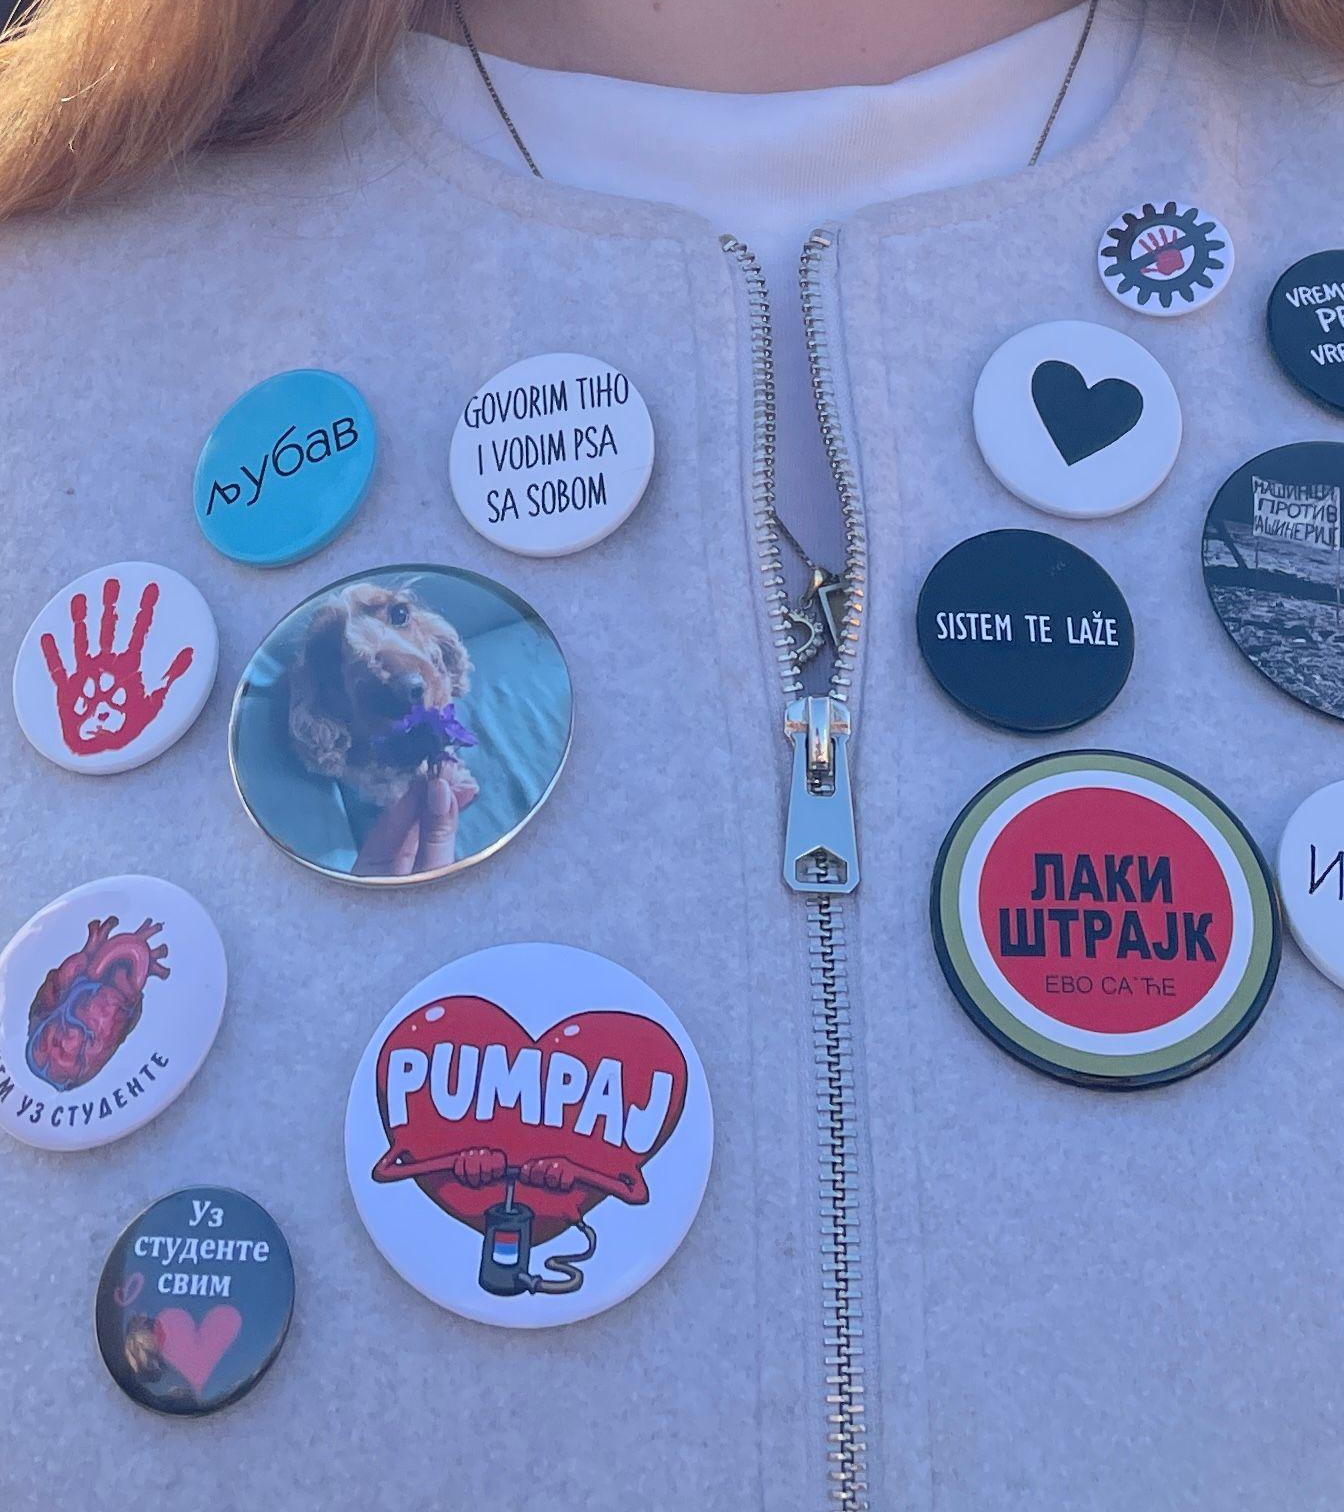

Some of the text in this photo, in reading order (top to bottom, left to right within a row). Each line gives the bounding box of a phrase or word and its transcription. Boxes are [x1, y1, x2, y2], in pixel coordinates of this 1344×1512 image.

[463, 371, 630, 429] GOVORIM TIHO
[205, 415, 360, 516] љубав
[477, 424, 619, 476] I VODIM PSA
[486, 472, 608, 524] SA SOBOM
[1258, 497, 1338, 524] ПРОТИВ
[936, 610, 1119, 646] SISTEM TE LAŽE
[1030, 852, 1174, 905] ЛАКИ
[998, 907, 1218, 964] ШТРАЈК
[1045, 975, 1093, 994] ЕВО
[16, 1094, 45, 1124] УЗ
[50, 1051, 170, 1128] СТУДЕНТЕ
[386, 1041, 674, 1155] PUMPAJ
[188, 1199, 225, 1228] Уз
[134, 1236, 270, 1266] студенте
[157, 1272, 233, 1298] свим
